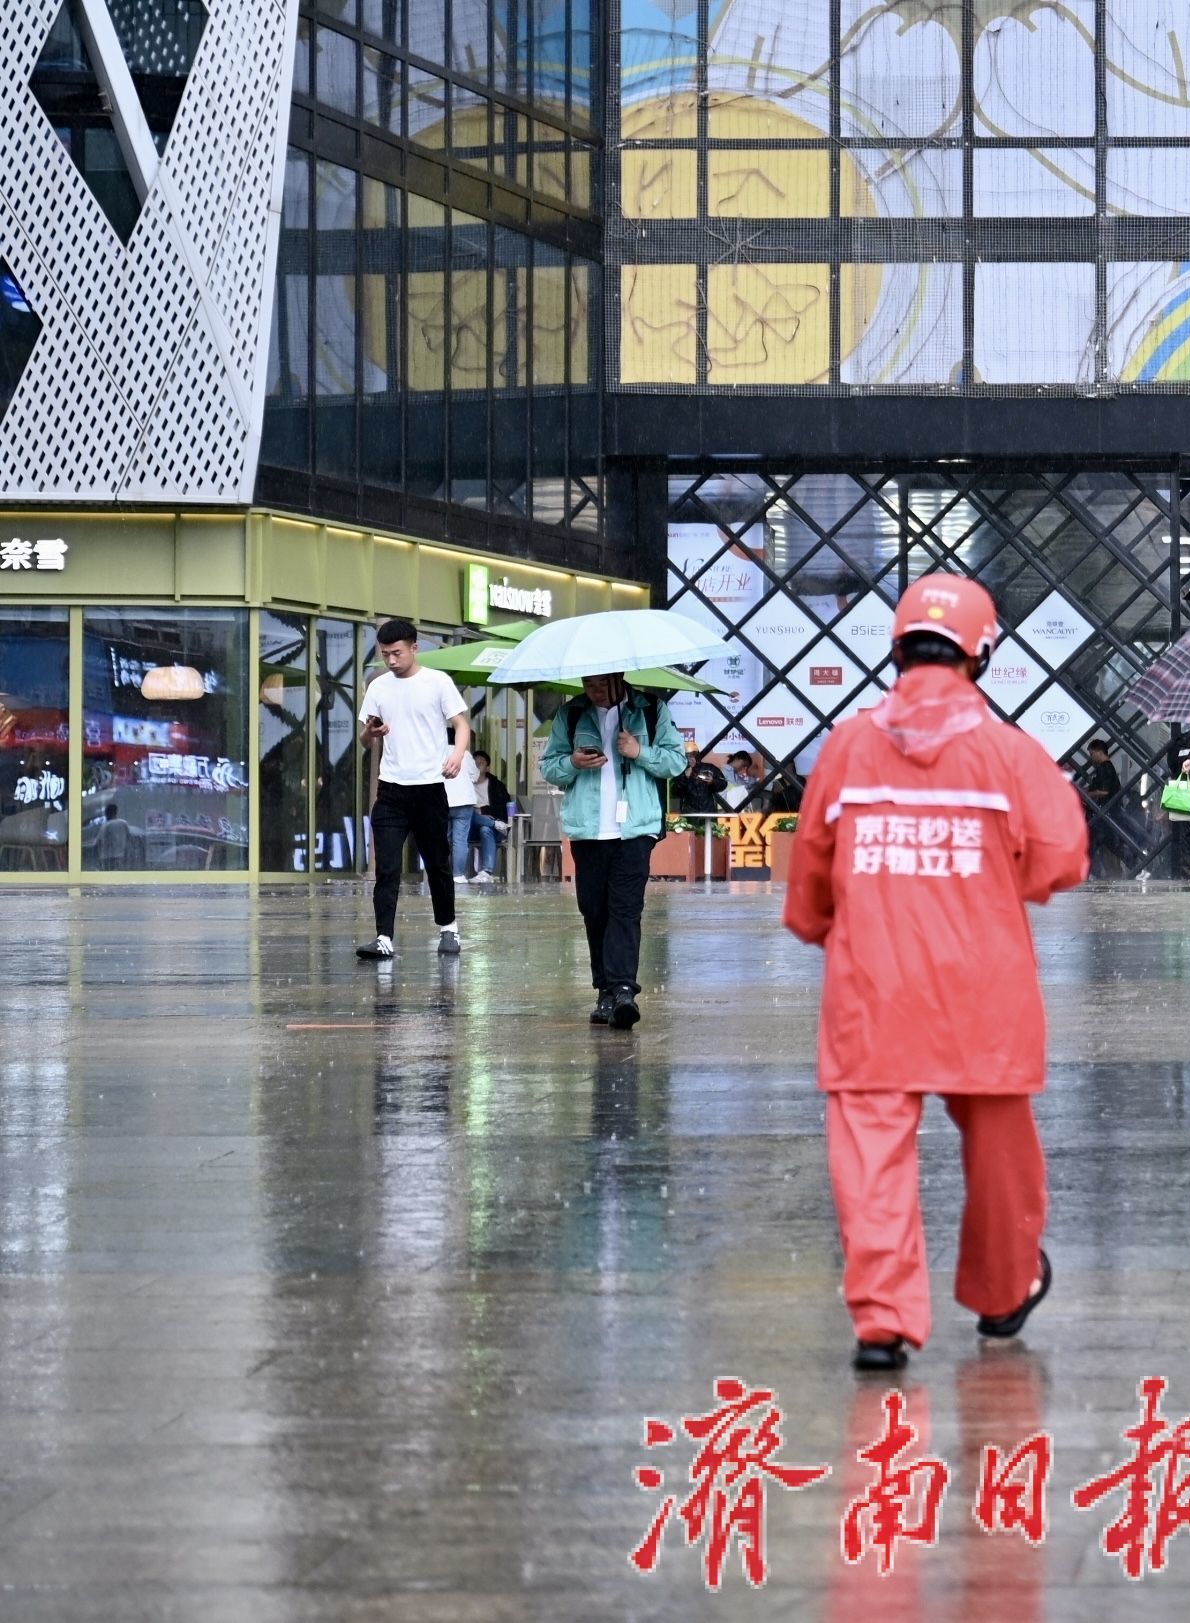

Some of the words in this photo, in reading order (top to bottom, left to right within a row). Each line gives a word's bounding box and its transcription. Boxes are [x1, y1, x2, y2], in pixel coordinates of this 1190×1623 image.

[0, 538, 69, 571] 奈雪
[991, 667, 1028, 679] 世纪缘
[758, 717, 784, 727] Lenovo
[854, 815, 982, 847] 京东秒送
